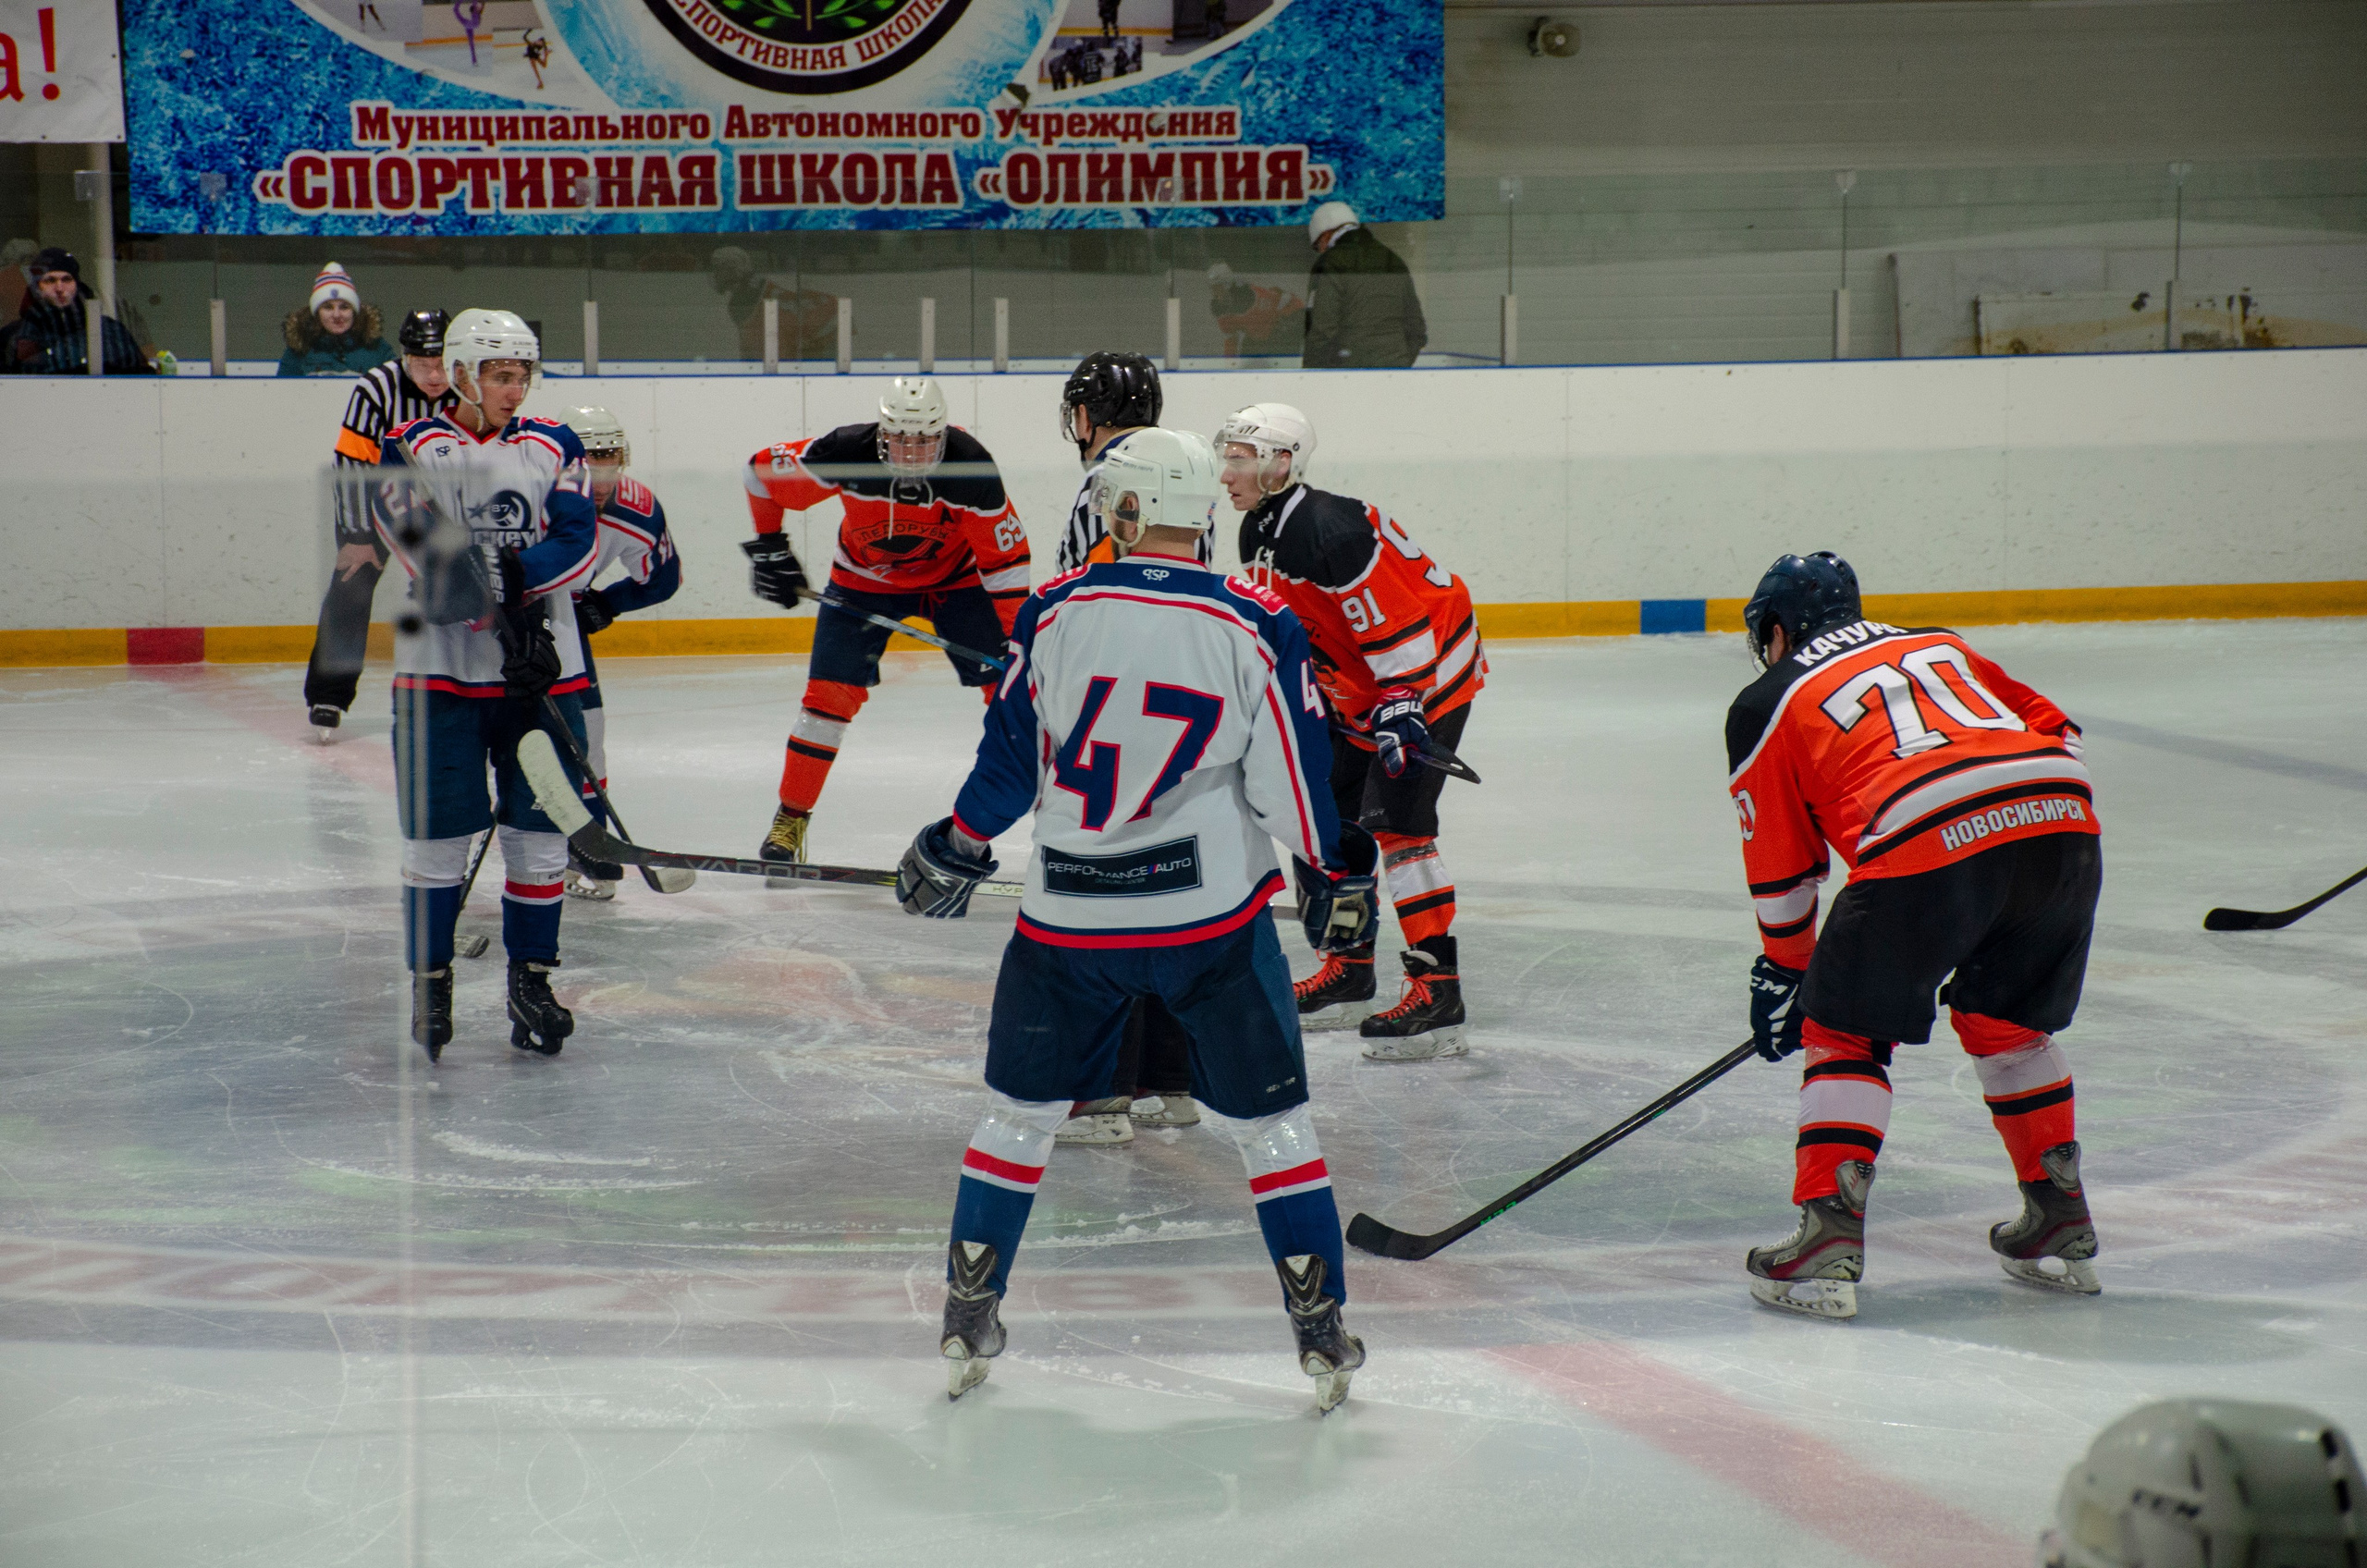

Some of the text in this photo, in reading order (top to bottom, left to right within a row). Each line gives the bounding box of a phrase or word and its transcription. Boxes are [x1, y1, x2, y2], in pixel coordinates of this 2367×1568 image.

[355, 106, 711, 150] Муниципального
[724, 104, 982, 139] Автономного
[258, 150, 1331, 210] «СПОРТИВНАЯ ШКОЛА «ОЛИМПИЯ»
[993, 511, 1027, 553] 69
[1341, 585, 1387, 634] 91
[1792, 619, 1910, 668] КАЧУРА
[1300, 656, 1327, 719] 4
[1818, 642, 2029, 761] 70
[1051, 675, 1225, 832] 47
[1940, 798, 2087, 852] НОВОСИБИРСК
